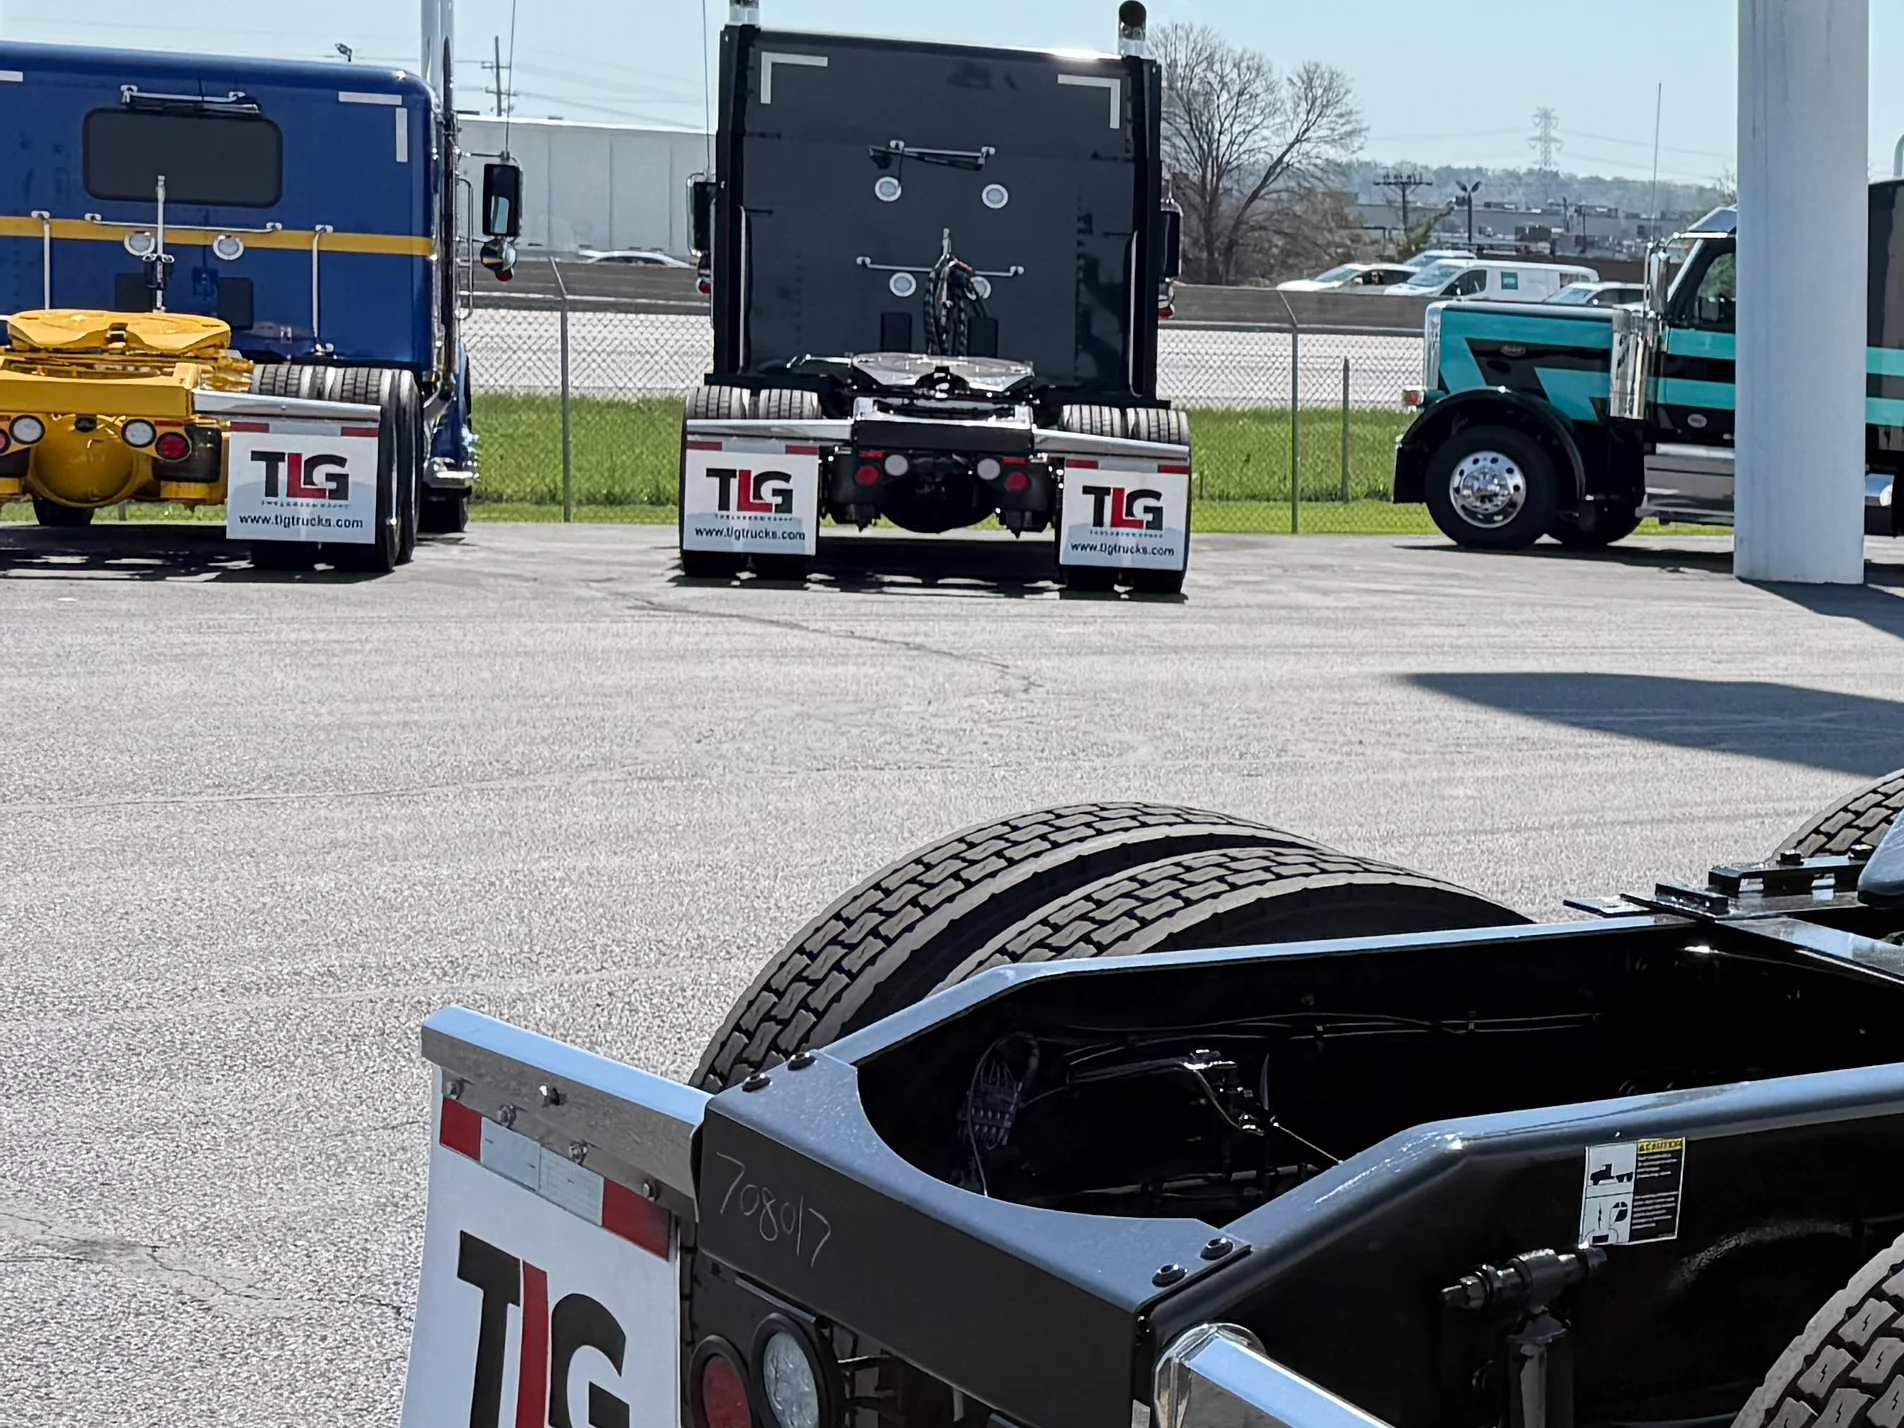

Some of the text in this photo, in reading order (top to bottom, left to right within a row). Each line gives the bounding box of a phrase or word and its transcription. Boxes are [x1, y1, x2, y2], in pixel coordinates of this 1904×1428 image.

[250, 450, 349, 501] TLG
[706, 468, 793, 514] TLG
[239, 513, 363, 529] www.tlgtrucks.com
[1082, 485, 1163, 531] TLG
[694, 526, 806, 541] www.tlgtrucks.com
[1070, 541, 1175, 557] www.tlgtrucks.com
[716, 1151, 831, 1269] 708017
